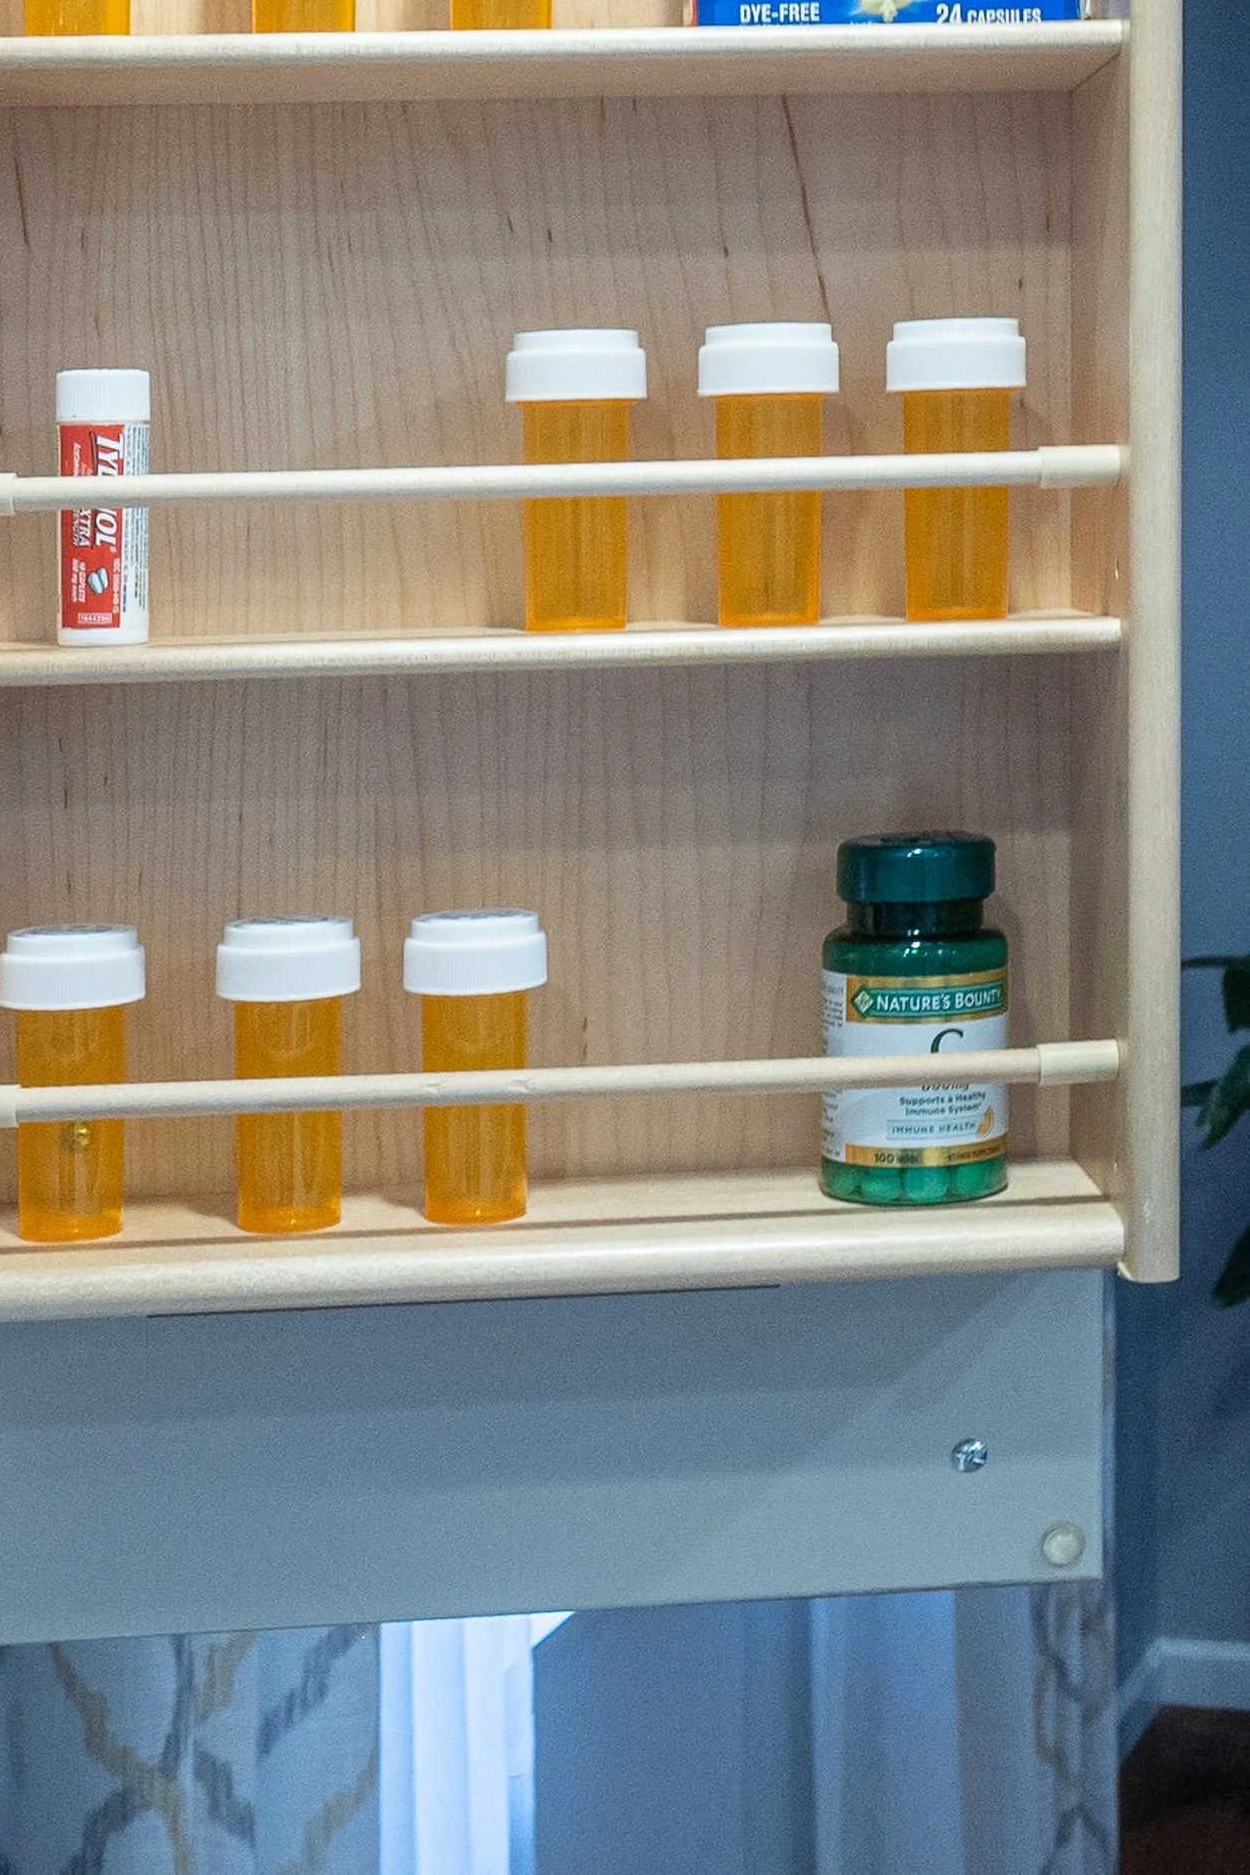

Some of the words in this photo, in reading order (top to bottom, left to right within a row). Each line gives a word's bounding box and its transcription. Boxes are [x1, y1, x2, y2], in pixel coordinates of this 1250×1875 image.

[739, 2, 820, 24] DYE-FREE
[936, 3, 961, 24] 24
[967, 8, 1042, 24] CAPSULES
[95, 433, 124, 548] TYLOL
[876, 993, 951, 1012] NATURE'S
[900, 1095, 945, 1107] Supports
[954, 1091, 987, 1104] Healthy
[905, 1106, 946, 1117] Immune
[892, 1125, 935, 1134] IMMUNE
[939, 1123, 976, 1134] HEALTH
[874, 1152, 894, 1163] 100
